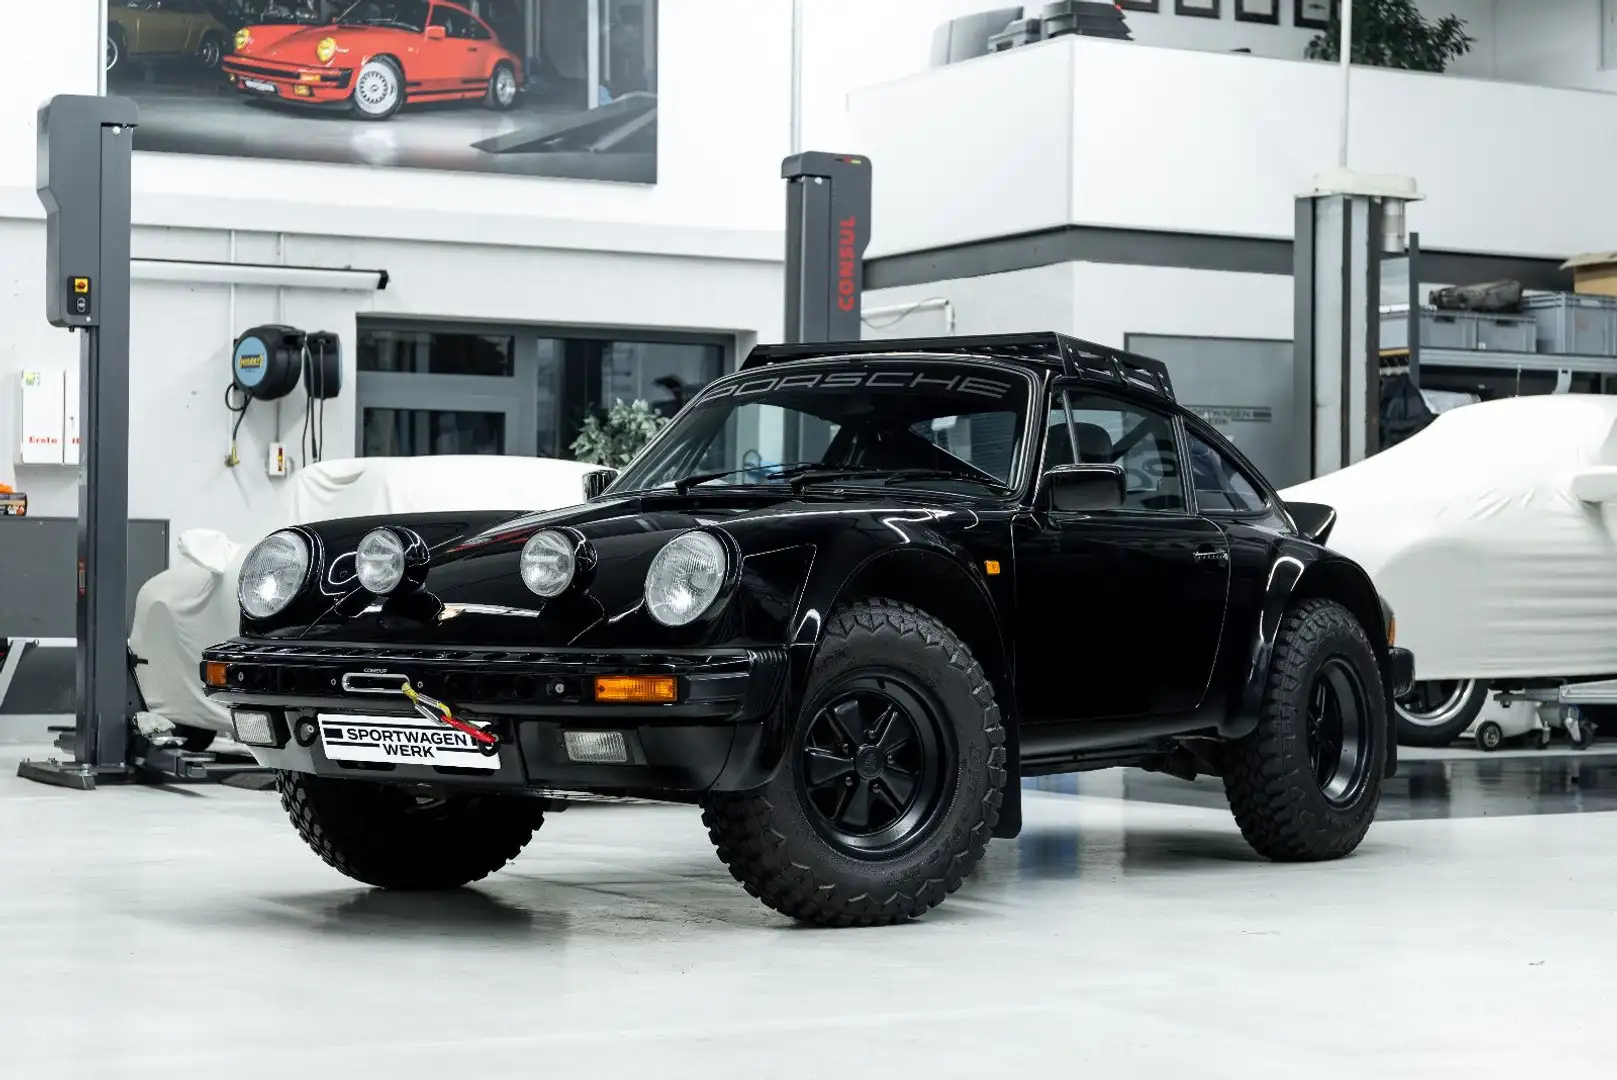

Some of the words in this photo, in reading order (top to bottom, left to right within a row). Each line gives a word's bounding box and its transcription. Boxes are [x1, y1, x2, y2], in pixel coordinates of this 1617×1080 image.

[838, 215, 856, 312] CONSUL
[695, 372, 1011, 406] PORSCHE
[347, 728, 467, 747] SPORTWAGEN
[383, 743, 435, 758] WERK
